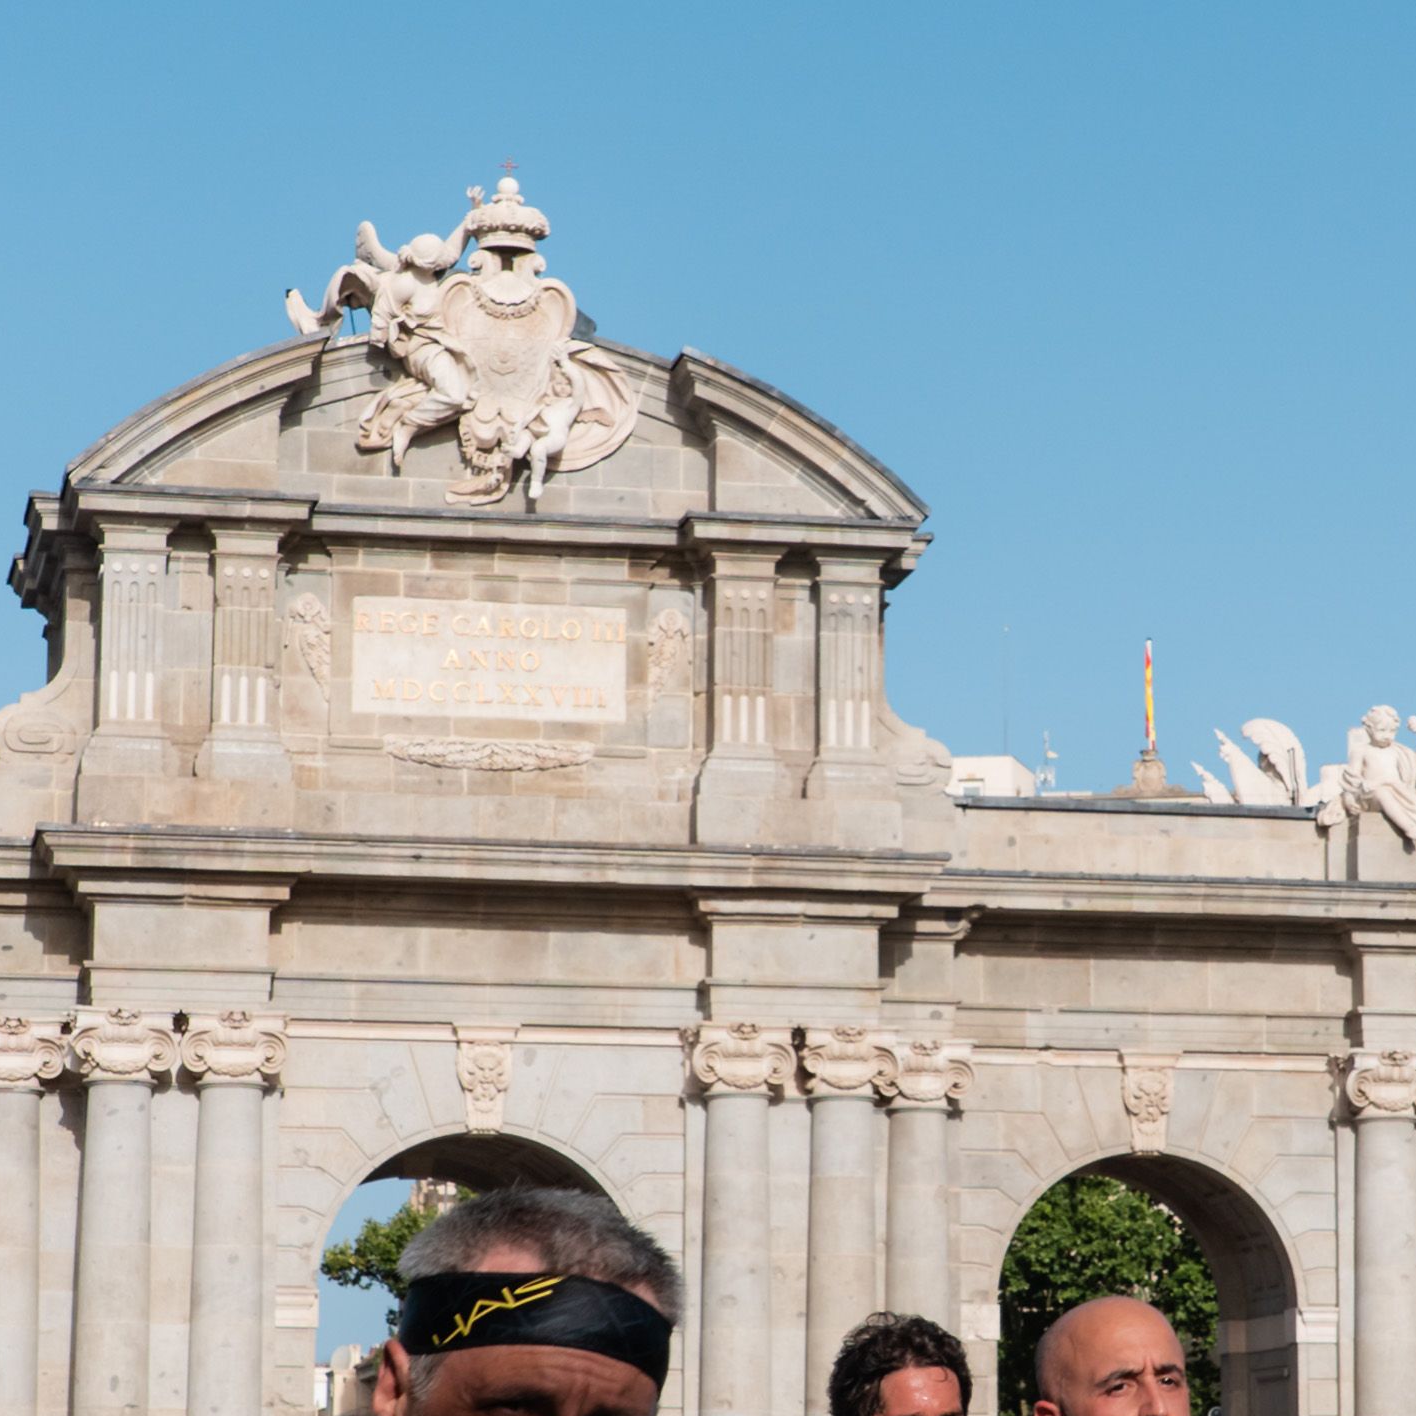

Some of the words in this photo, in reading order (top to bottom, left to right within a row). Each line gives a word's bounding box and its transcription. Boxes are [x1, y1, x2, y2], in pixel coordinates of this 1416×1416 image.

[354, 611, 440, 636] REGE
[450, 614, 582, 641] CAROLO
[592, 621, 626, 643] III
[439, 648, 540, 672] ANNO
[371, 677, 606, 708] MDCCLXXVIII
